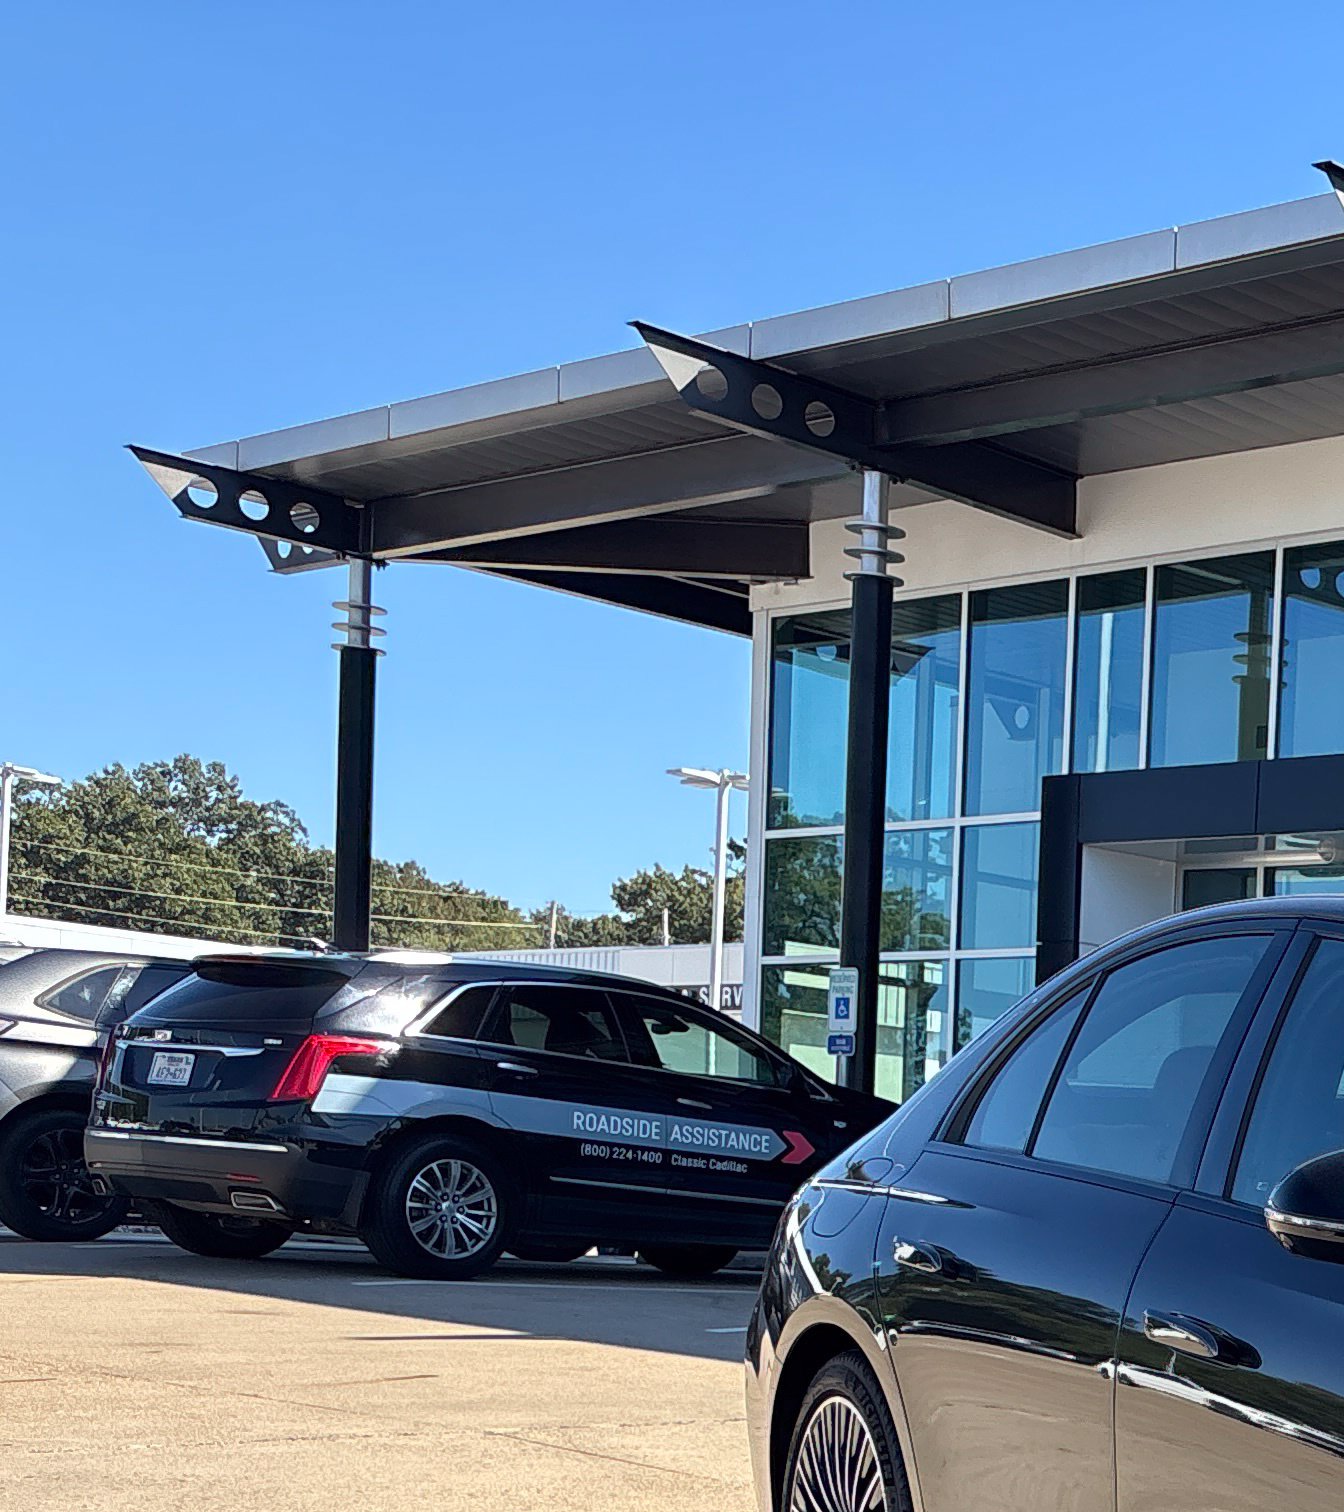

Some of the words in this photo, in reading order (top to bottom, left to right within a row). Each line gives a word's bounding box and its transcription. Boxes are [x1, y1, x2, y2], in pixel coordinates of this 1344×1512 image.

[573, 1111, 661, 1140] ROADSIDE
[669, 1124, 770, 1153] ASSISTANCE
[580, 1142, 610, 1158] (800)
[612, 1147, 663, 1164] 224-1400
[671, 1154, 707, 1170] Classic
[709, 1158, 748, 1174] Cadillac
